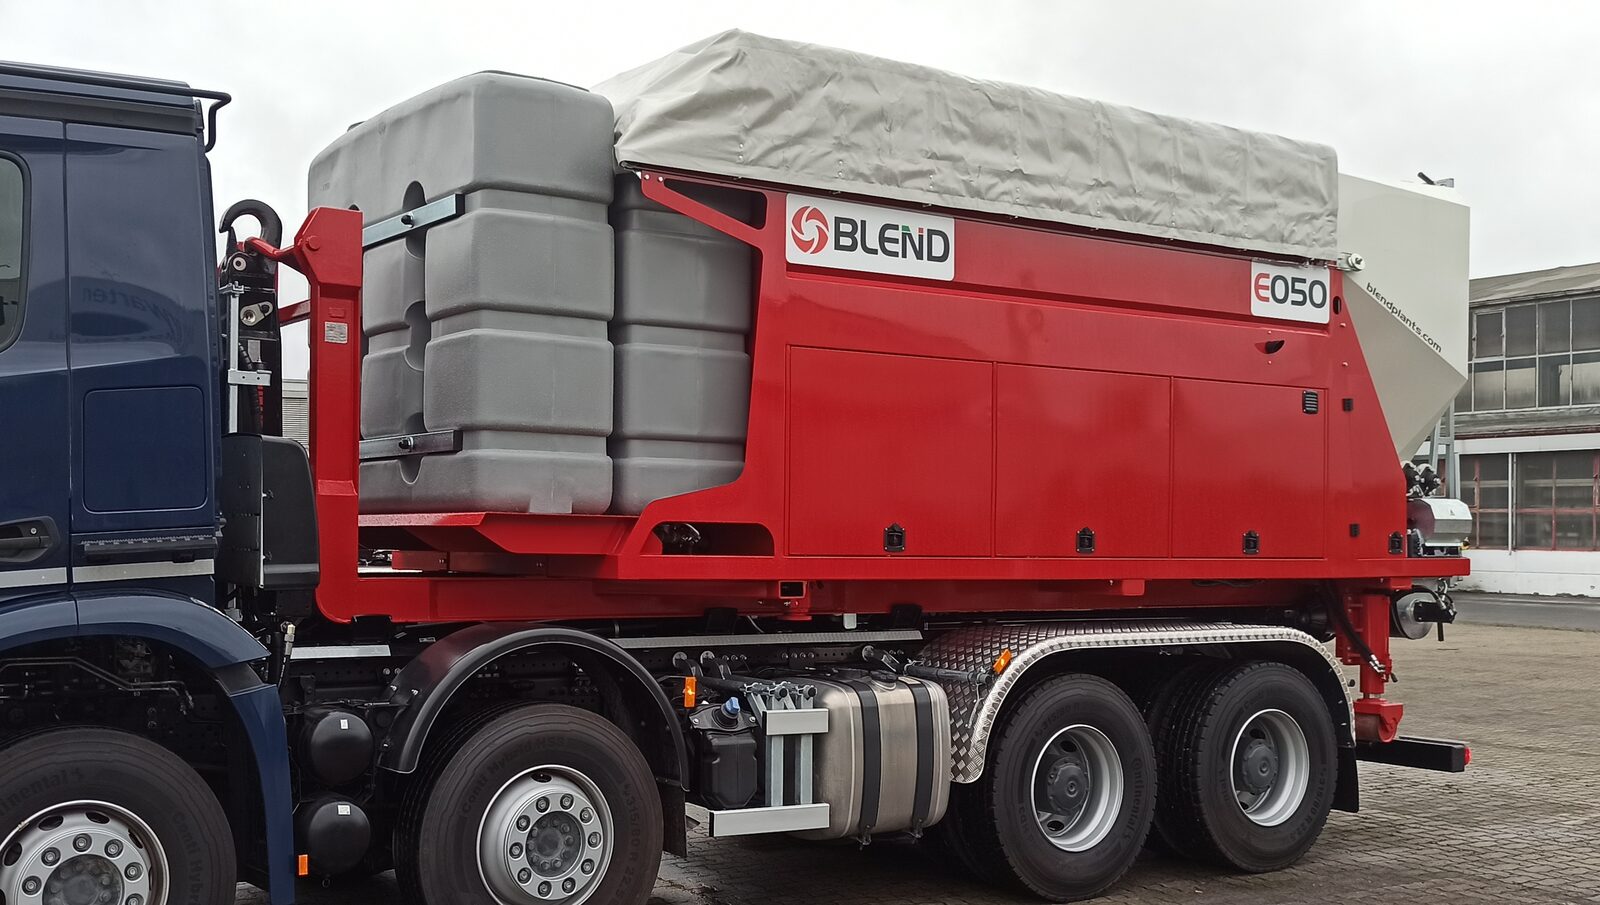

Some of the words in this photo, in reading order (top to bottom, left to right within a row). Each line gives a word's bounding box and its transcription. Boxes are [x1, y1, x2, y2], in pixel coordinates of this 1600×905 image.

[834, 216, 950, 263] BLEND
[1254, 272, 1327, 309] E050
[1366, 282, 1443, 353] blendplants.com
